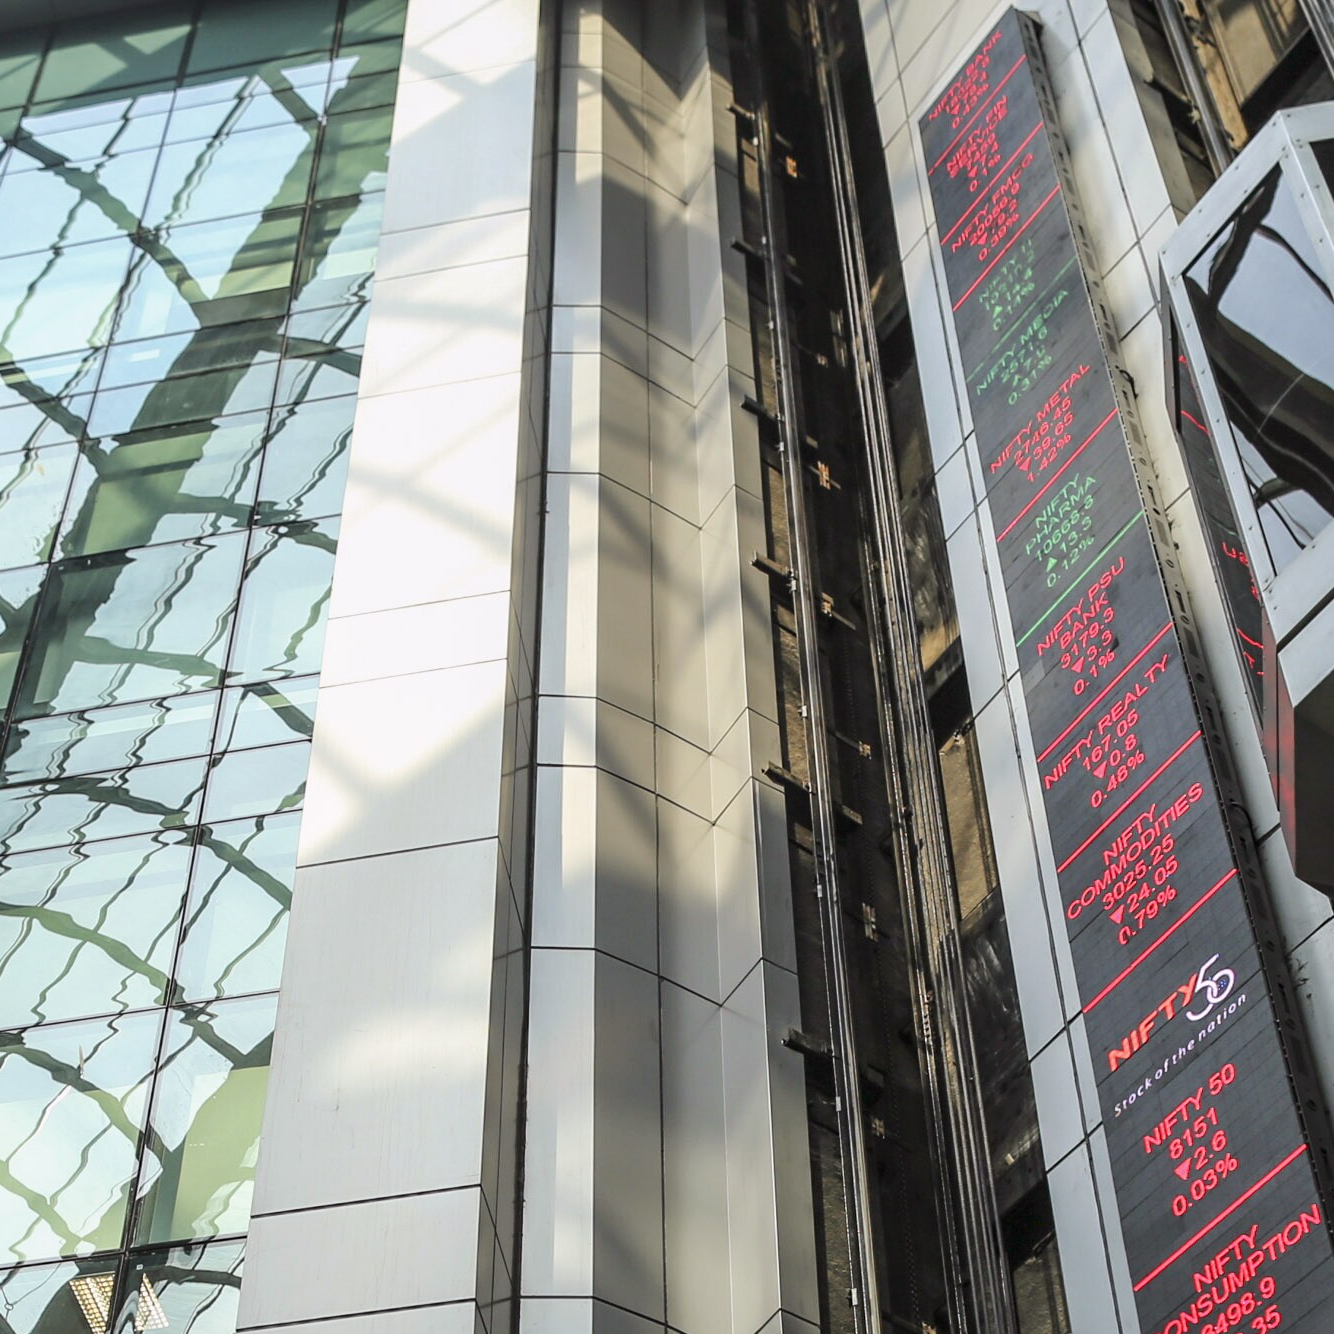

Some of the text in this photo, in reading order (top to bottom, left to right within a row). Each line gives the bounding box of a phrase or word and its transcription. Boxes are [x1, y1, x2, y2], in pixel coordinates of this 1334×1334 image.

[951, 203, 988, 252] NIFTY
[977, 344, 1016, 395] NIFTY
[990, 364, 1090, 474] NIFTY METAL
[1026, 478, 1094, 553] PHARMA
[1037, 477, 1080, 524] NIFTY
[1048, 537, 1093, 587] 0.12%
[1039, 557, 1124, 655] NIFTY PSU
[1061, 593, 1109, 648] BANK
[1061, 608, 1114, 669] 3179.3
[1089, 630, 1113, 660] 3.3
[1075, 651, 1115, 695] 0.1%
[1044, 657, 1167, 789] NIFTY REALTY
[1085, 710, 1138, 770] 167.05
[1109, 735, 1137, 766] 0.8
[1092, 752, 1144, 808] 0.48%
[1069, 784, 1203, 920] COMMODITIES
[1105, 805, 1158, 865] NIFTY
[1103, 836, 1175, 910] 3025.25
[1127, 856, 1179, 912] 24.05
[1119, 888, 1176, 945] 0.79%
[1199, 993, 1246, 1041] nation
[1143, 1063, 1236, 1153] NIFTY 50
[1169, 1107, 1218, 1159] 8151
[1194, 1130, 1226, 1170] 2.6
[1172, 1153, 1238, 1216] 0.03%
[1193, 1224, 1259, 1292] NIFTY
